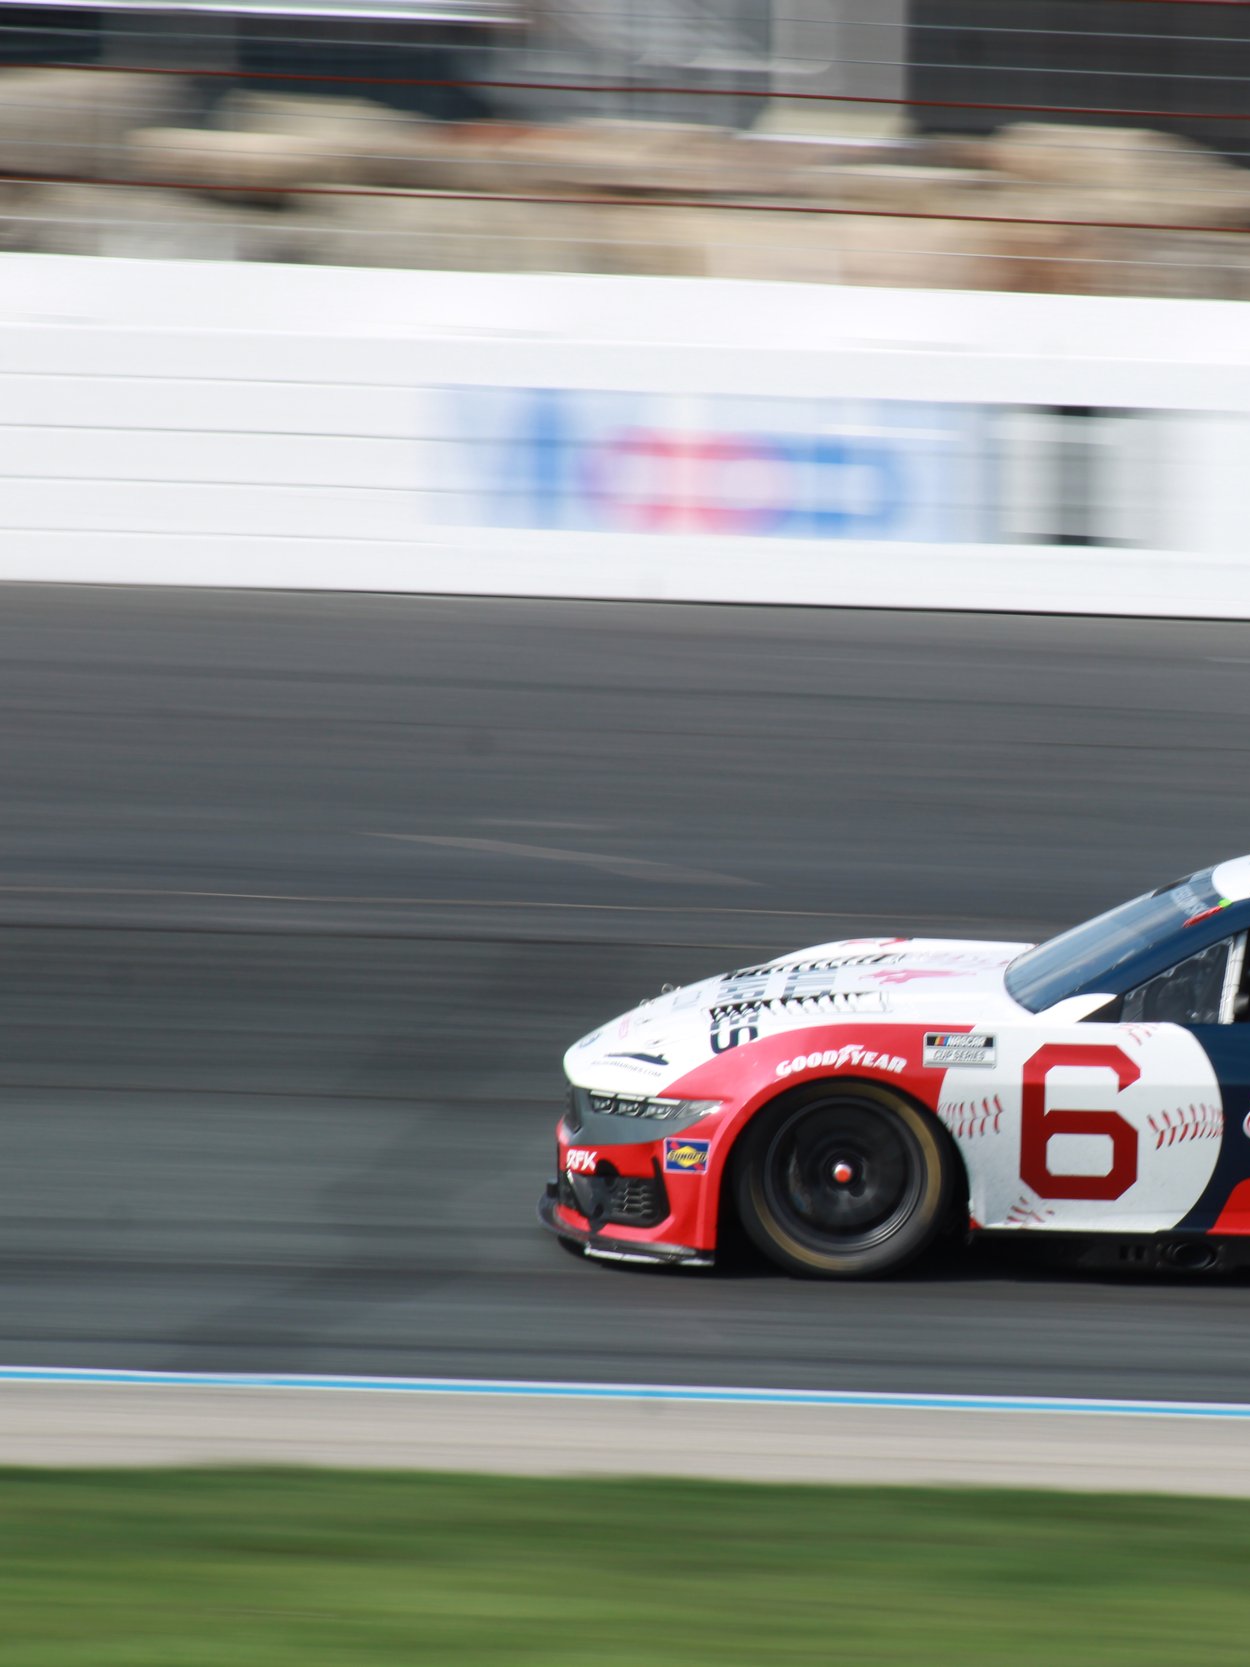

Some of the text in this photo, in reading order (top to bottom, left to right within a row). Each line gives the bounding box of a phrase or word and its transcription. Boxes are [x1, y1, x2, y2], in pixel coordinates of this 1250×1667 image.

[946, 1035, 985, 1047] NASCAR
[775, 1044, 907, 1077] GOODYEAR
[1019, 1043, 1141, 1201] 6
